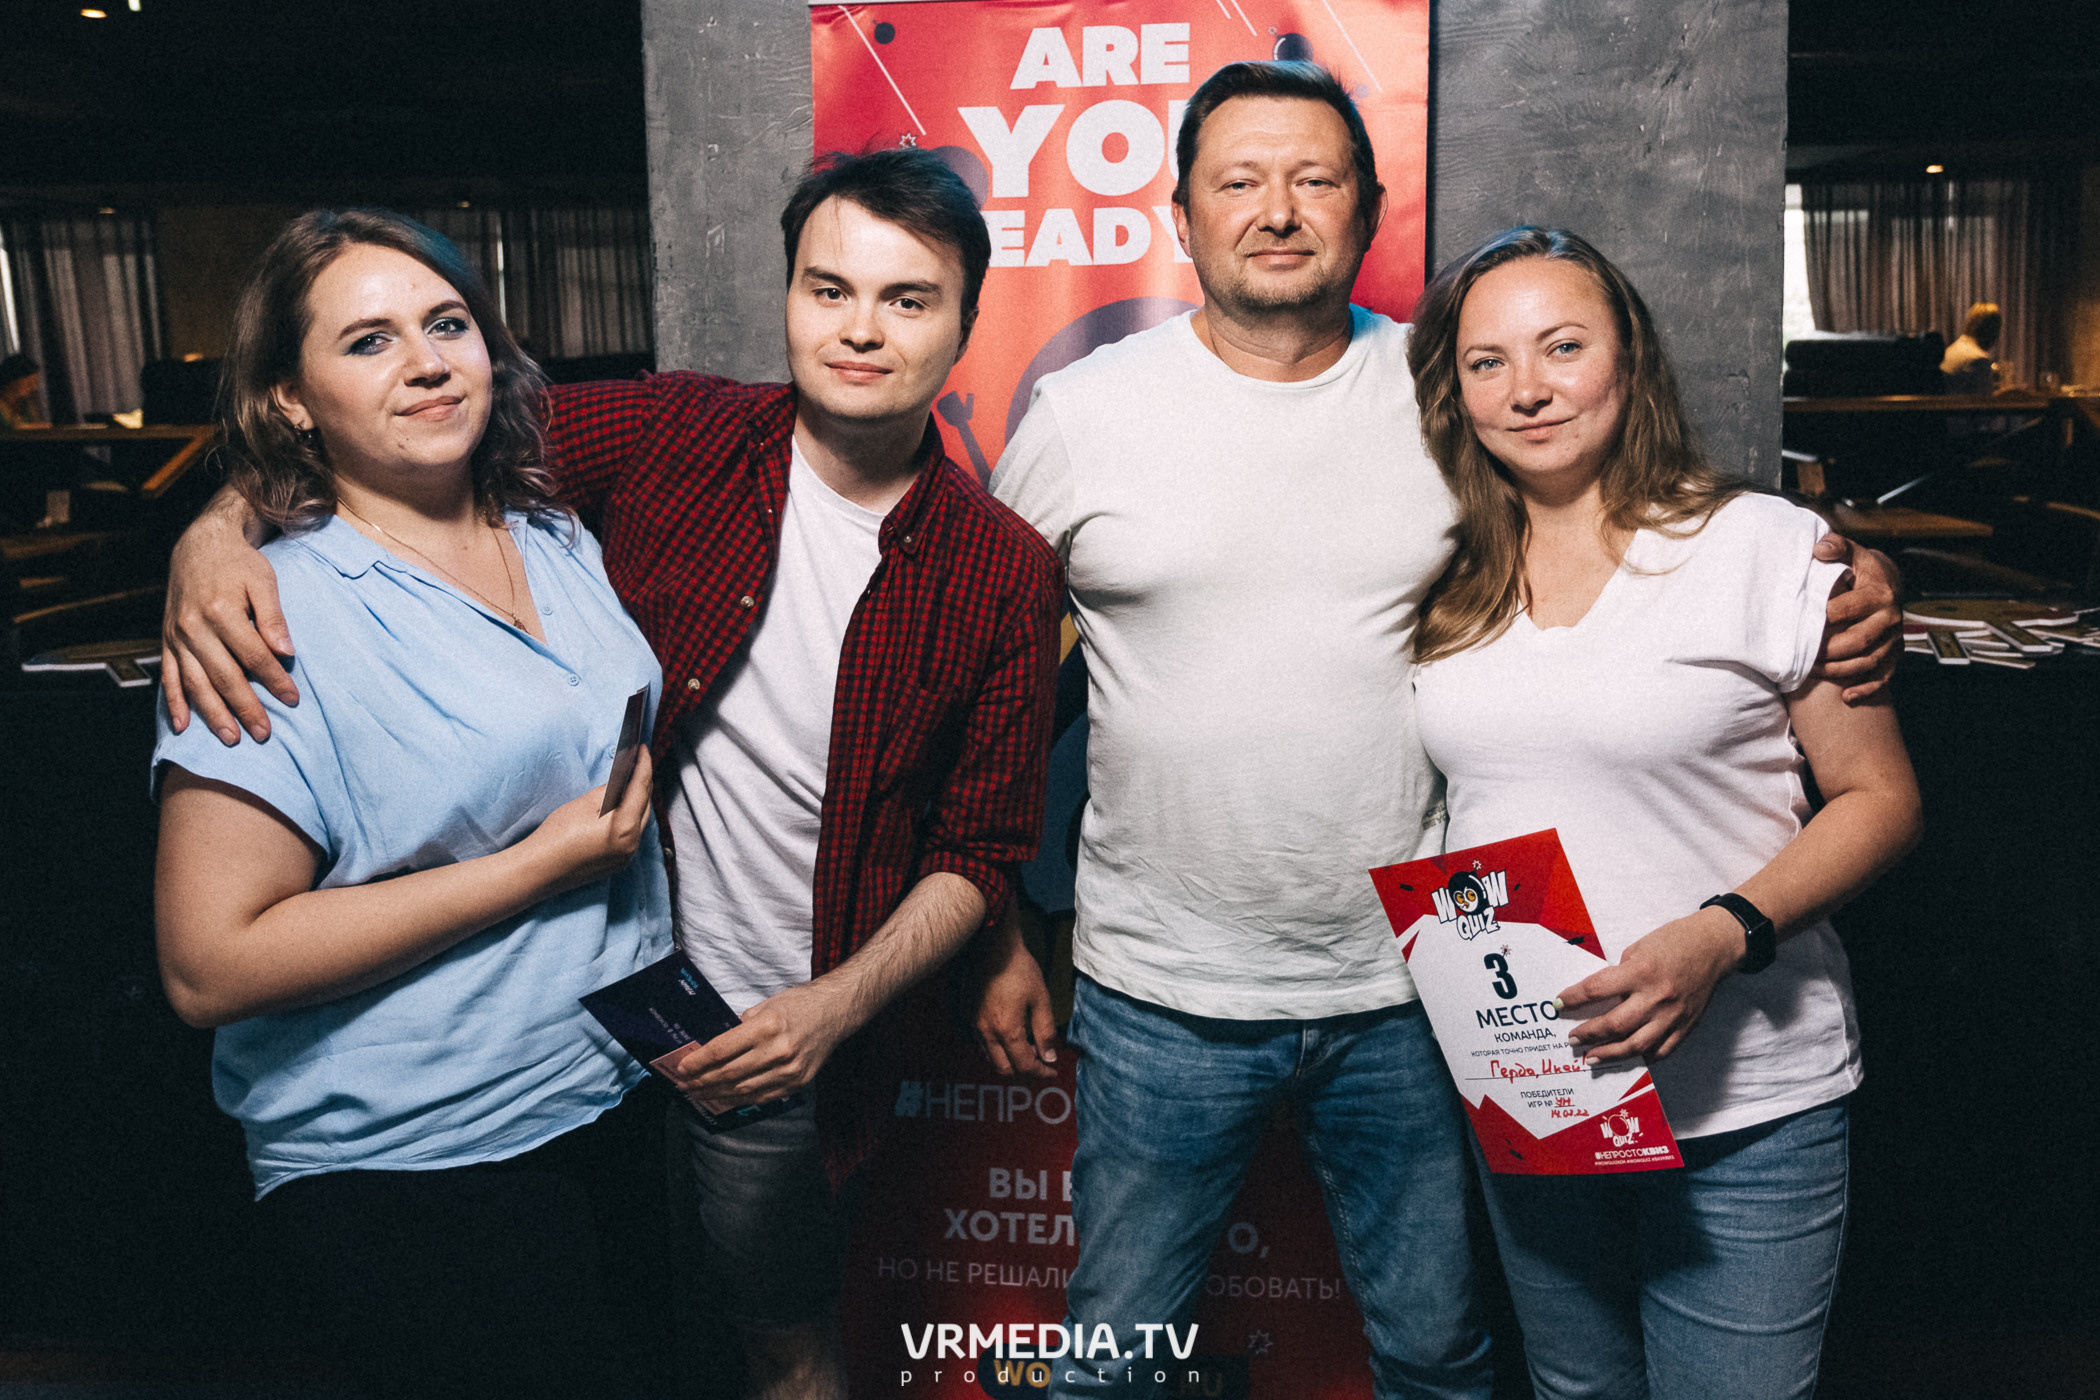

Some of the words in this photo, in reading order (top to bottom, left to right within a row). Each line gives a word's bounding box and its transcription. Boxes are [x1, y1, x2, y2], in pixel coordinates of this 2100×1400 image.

[1010, 22, 1190, 90] ARE
[981, 206, 1193, 268] EADY
[1456, 905, 1500, 941] QUIZ
[1483, 953, 1518, 1000] 3
[1475, 1000, 1560, 1029] МЕСТО
[1470, 1049, 1500, 1057] КОТОРАЯ
[1501, 1047, 1524, 1056] ТОЧНО
[1524, 1043, 1551, 1053] ПРИДЕТ
[1552, 1042, 1563, 1050] НА
[1494, 1027, 1557, 1043] КОМАНДА,
[895, 1080, 1073, 1125] #НЕПРО
[1520, 1088, 1575, 1099] ПОБЕДИТЕЛИ
[989, 1167, 1048, 1200] ВЫ
[944, 1208, 1076, 1247] ХОТЕЛ
[878, 1256, 918, 1280] НО
[926, 1259, 960, 1283] НЕ
[1205, 1274, 1341, 1300] ОБОВАТЬ!
[993, 1359, 1051, 1388] WO
